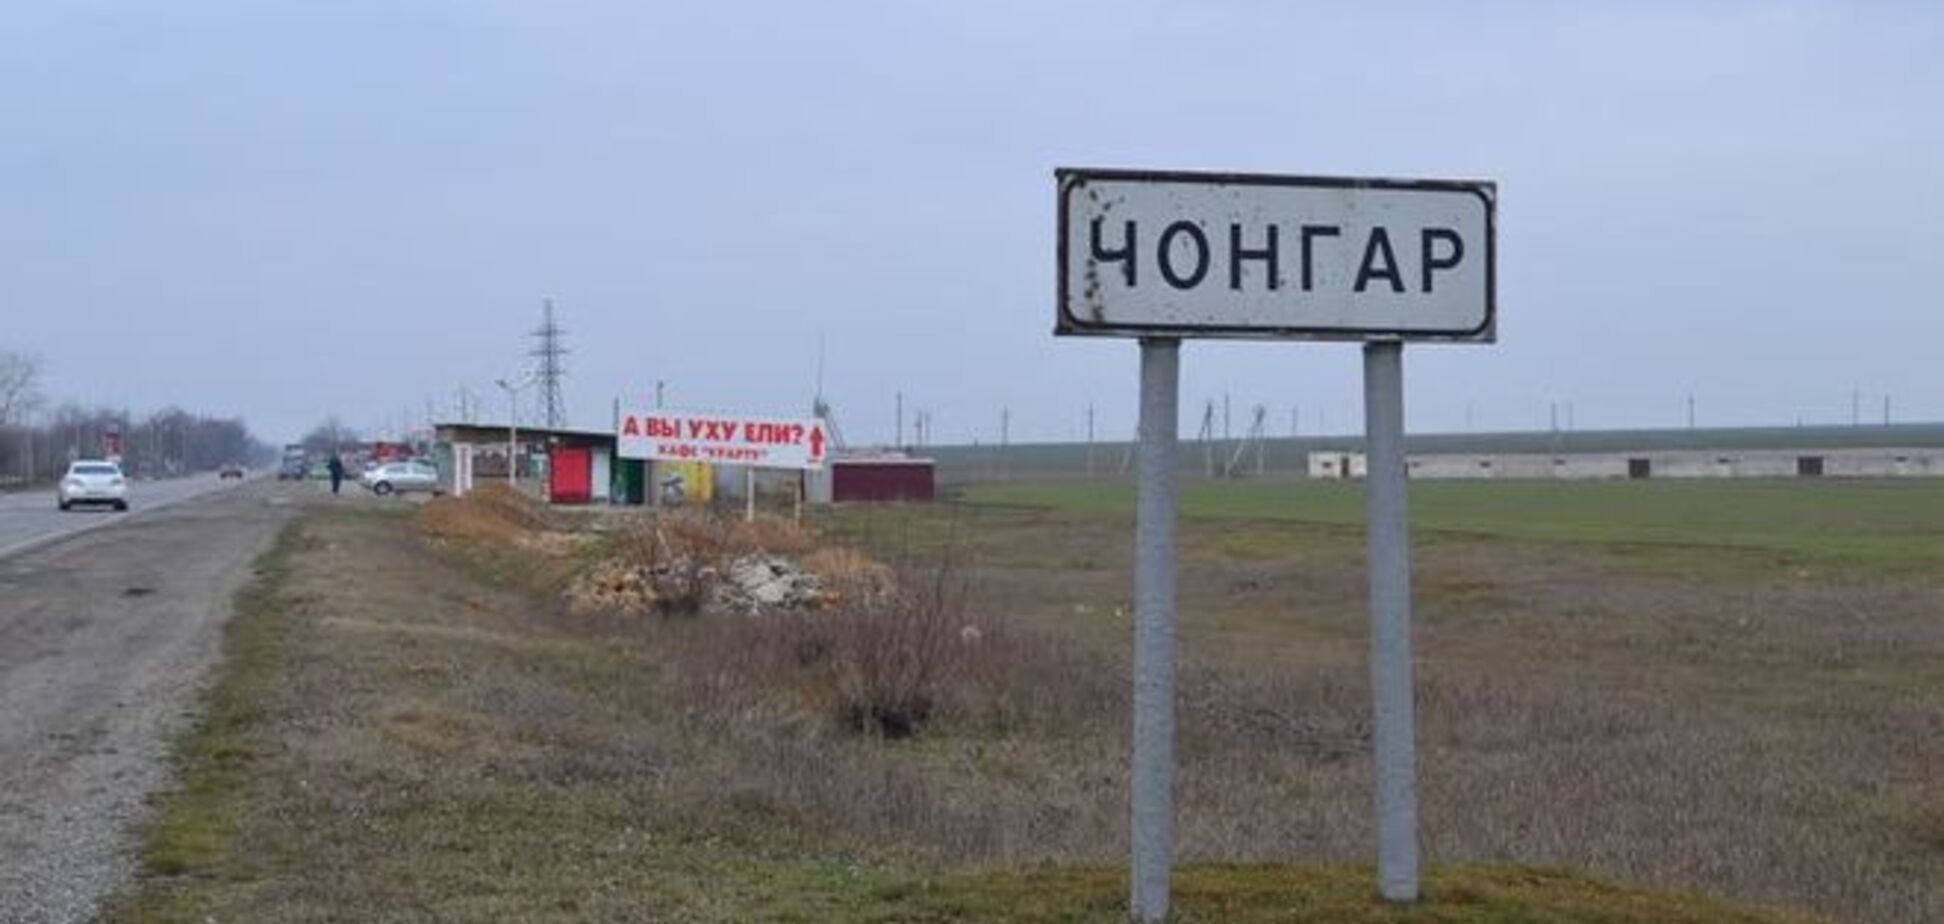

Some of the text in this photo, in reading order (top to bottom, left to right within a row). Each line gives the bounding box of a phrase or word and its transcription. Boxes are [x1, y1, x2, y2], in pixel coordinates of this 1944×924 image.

[1090, 219, 1465, 293] ЧОНГАР
[623, 415, 804, 445] А ВЫ УХУ ЕЛИ?
